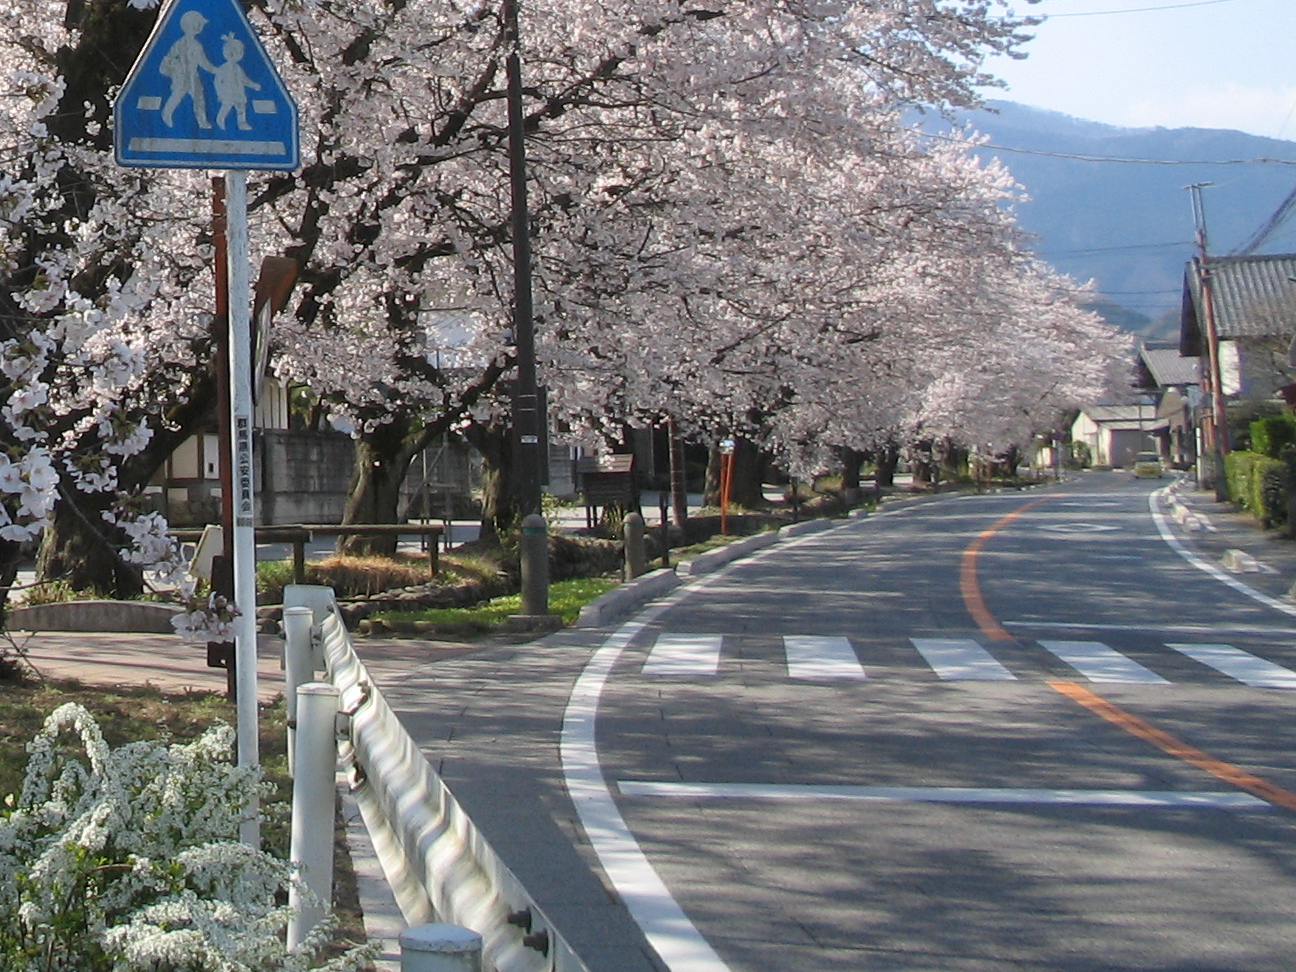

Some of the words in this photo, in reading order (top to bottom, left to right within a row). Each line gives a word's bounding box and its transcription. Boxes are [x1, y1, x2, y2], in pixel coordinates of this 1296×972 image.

[237, 418, 251, 512] 群馬県公安委員会
